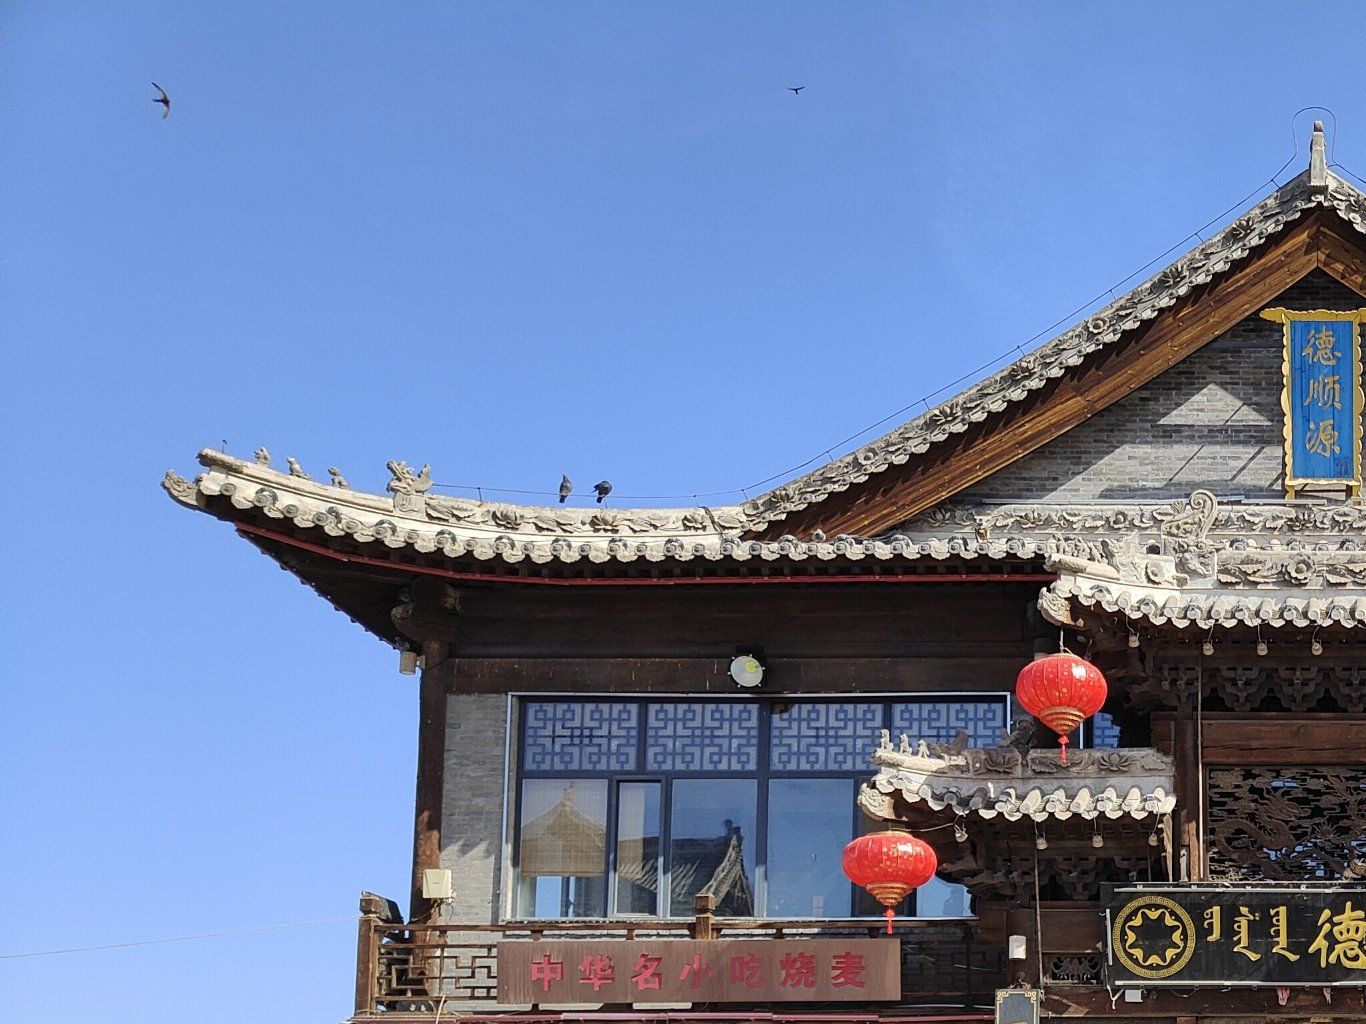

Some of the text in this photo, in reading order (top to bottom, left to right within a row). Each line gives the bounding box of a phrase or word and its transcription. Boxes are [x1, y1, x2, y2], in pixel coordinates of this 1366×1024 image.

[1302, 325, 1342, 457] 德顺源
[530, 951, 867, 992] 中华名小吃烧麦
